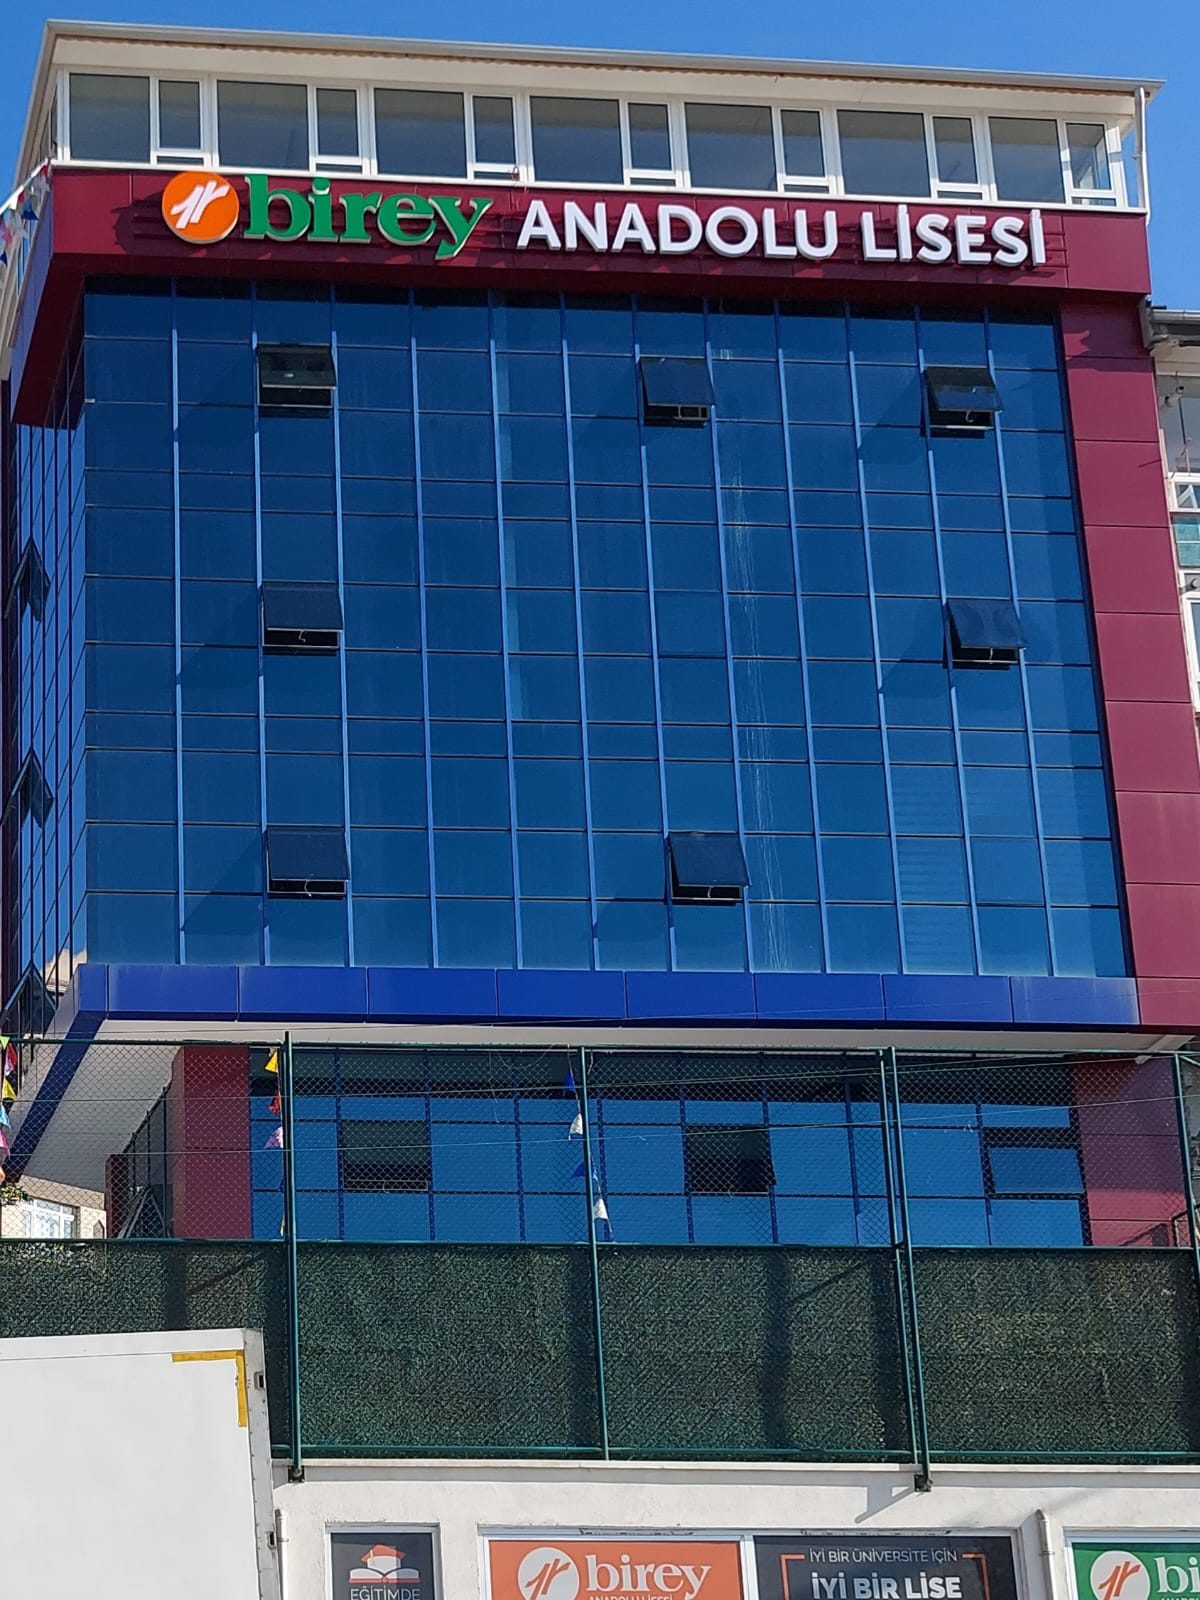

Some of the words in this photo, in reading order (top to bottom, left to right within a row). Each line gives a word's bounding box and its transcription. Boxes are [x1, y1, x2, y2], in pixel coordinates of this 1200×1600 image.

[243, 174, 494, 260] birey
[516, 199, 838, 261] ANADOLU
[860, 203, 1047, 267] LİSESİ
[809, 1548, 825, 1562] İYİ
[828, 1548, 850, 1562] BİR
[852, 1548, 928, 1563] ÜNİVERSİTE
[931, 1548, 958, 1564] İÇİN
[350, 1585, 421, 1600] EĞİTİMDE
[584, 1553, 712, 1600] birey
[811, 1572, 847, 1599] İYİ
[853, 1572, 899, 1599] BİR
[904, 1572, 962, 1599] LİSE
